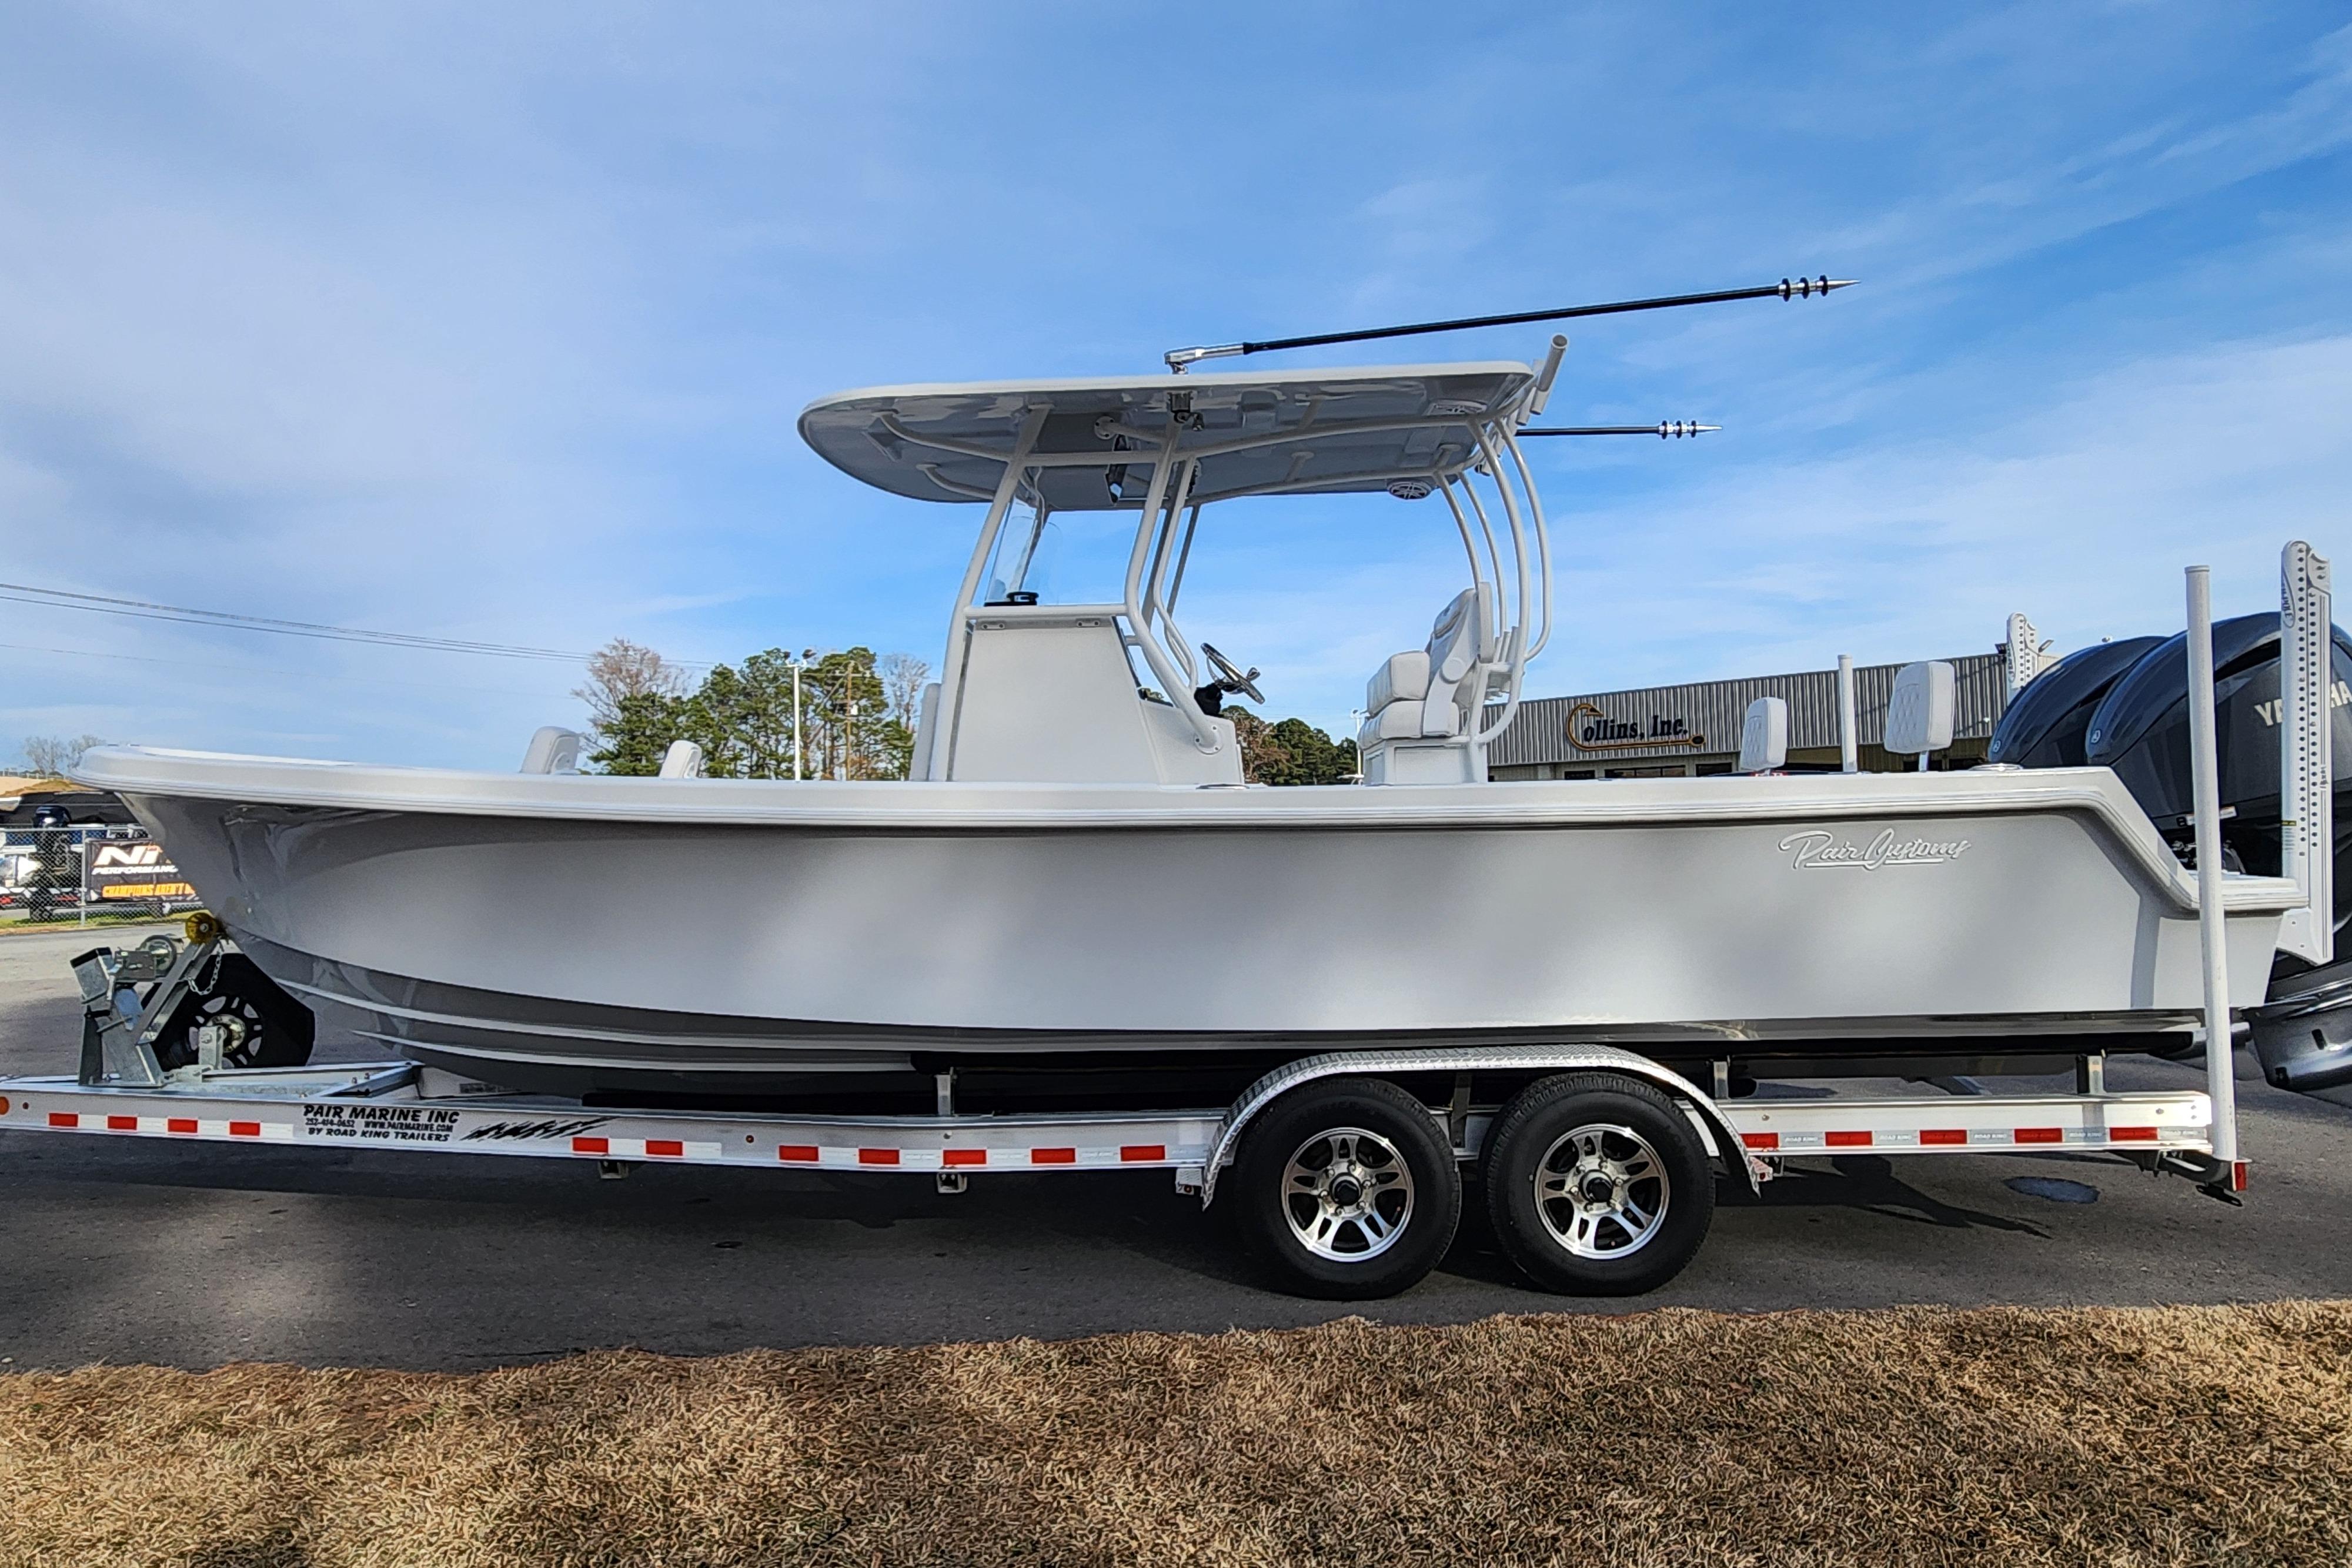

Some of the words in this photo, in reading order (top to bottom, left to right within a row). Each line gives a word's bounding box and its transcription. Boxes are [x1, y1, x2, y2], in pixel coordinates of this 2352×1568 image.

[1651, 714, 1688, 737] Inc.
[1778, 830, 1865, 870] Pair
[1863, 822, 1971, 871] Customs
[303, 1105, 344, 1118] PAIR
[349, 1107, 422, 1122] MARINE
[427, 1110, 460, 1124] INC
[326, 1128, 358, 1137] ROAD
[360, 1130, 390, 1139] KING
[394, 1131, 450, 1141] TRAILERS
